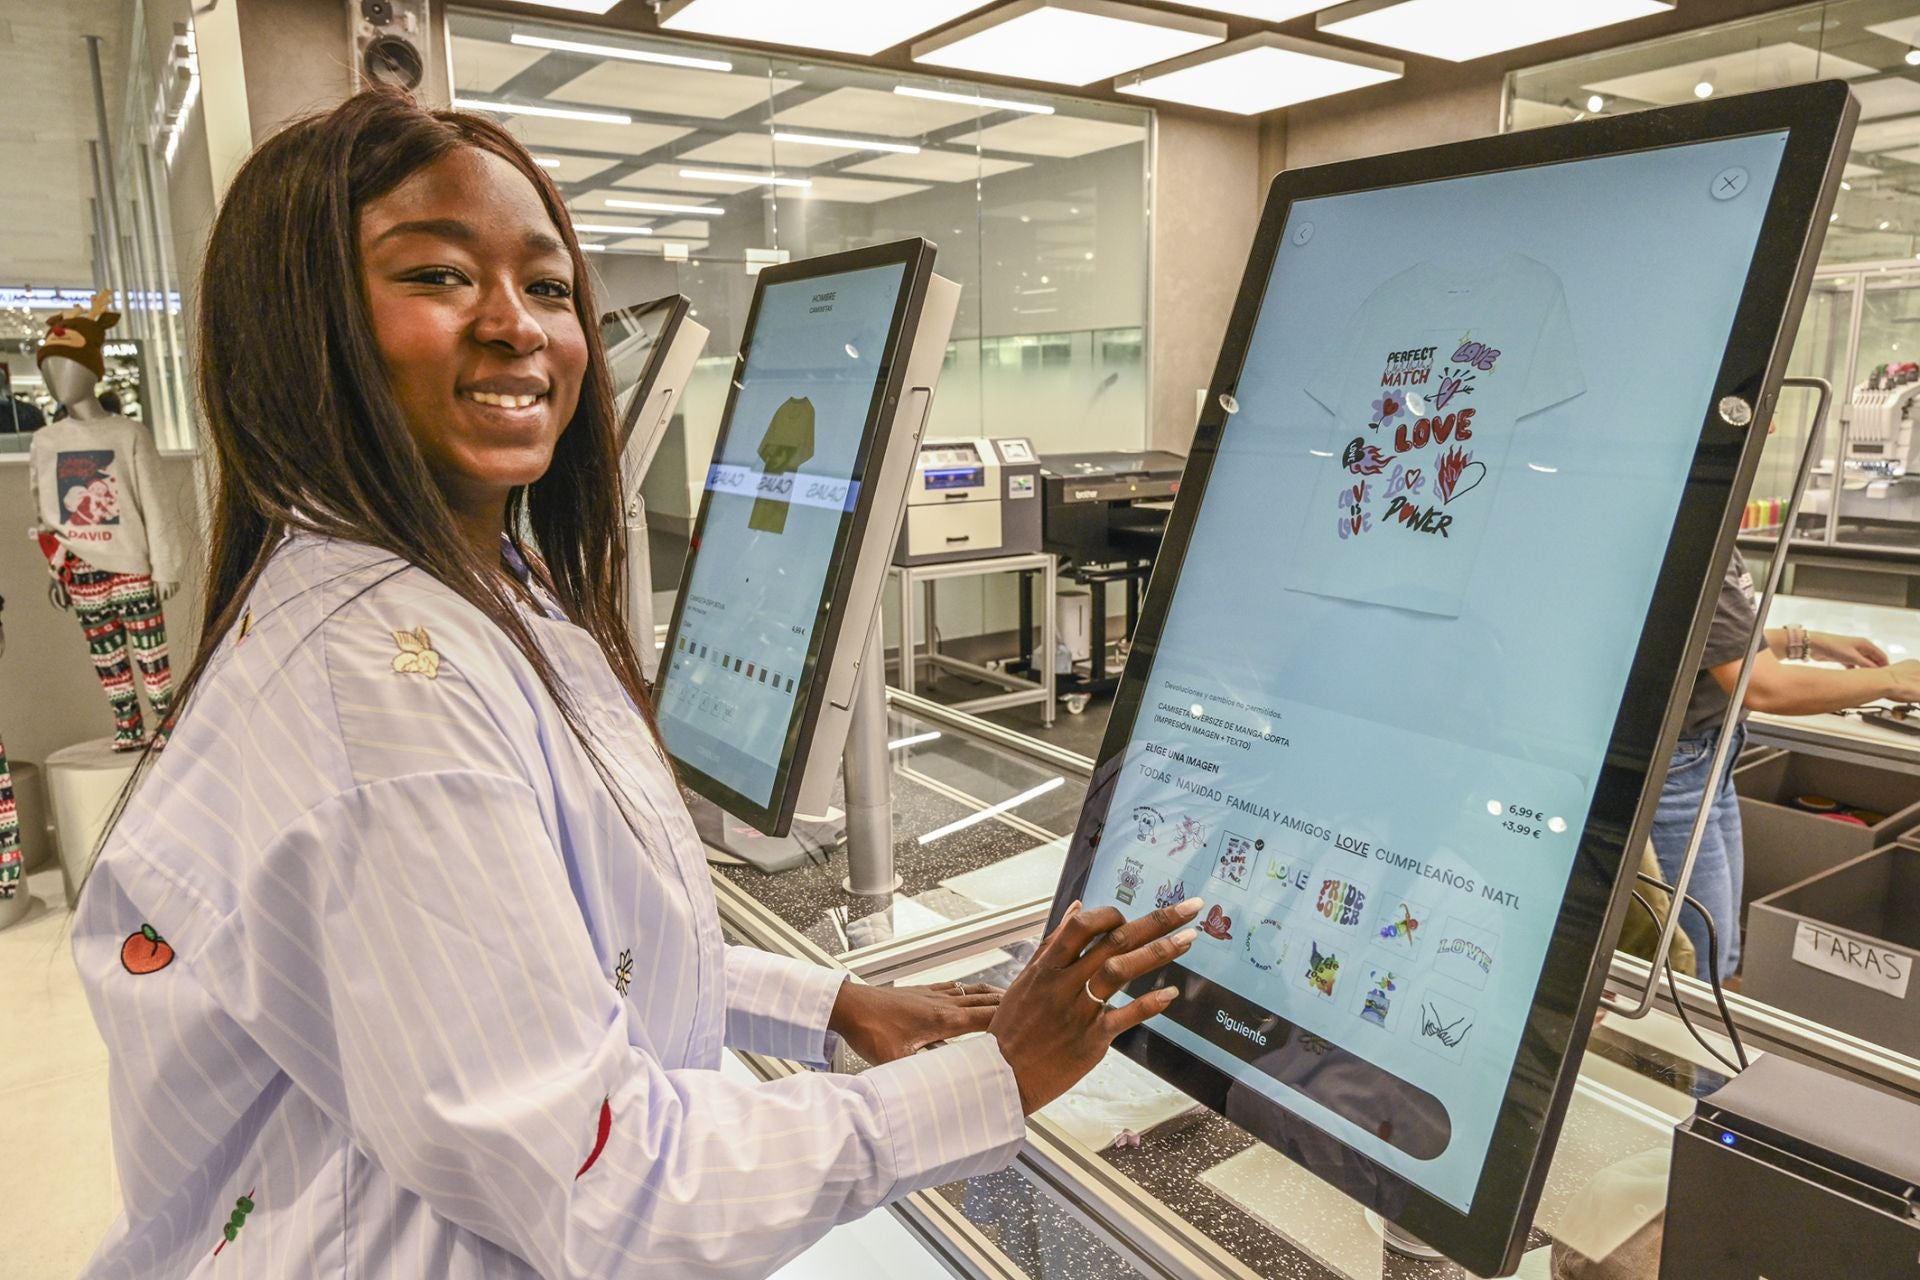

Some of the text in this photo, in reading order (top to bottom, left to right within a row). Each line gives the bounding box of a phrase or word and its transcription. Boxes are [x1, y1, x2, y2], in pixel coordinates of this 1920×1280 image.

[1387, 346, 1438, 363] PERFECT
[1451, 341, 1501, 371] LOVE
[1381, 368, 1431, 387] MATCH
[1394, 408, 1476, 453] LOVE
[1338, 480, 1373, 509] LOVE
[68, 531, 112, 541] DAVID
[1338, 514, 1373, 540] LOVE
[1164, 681, 1203, 698] Devoluciones
[1209, 694, 1235, 707] cambios
[1236, 701, 1244, 709] no
[1154, 714, 1192, 732] (IMPRESIÓN
[1192, 726, 1220, 740] IMAGEN
[1226, 735, 1252, 751] TEXTO)
[1158, 702, 1190, 718] CAMISETA
[1224, 721, 1235, 731] DE
[1235, 724, 1263, 739] MANGA
[1264, 733, 1290, 748] CORTA
[1145, 742, 1220, 774] ELIGE UNA IMAGEN
[1139, 764, 1172, 784] TODAS
[1176, 777, 1222, 802] NAVIDAD
[1226, 795, 1270, 820] FAMILIA
[1272, 810, 1282, 822] Y
[1281, 815, 1332, 841] AMIGOS
[1333, 833, 1371, 857] LOVE
[1375, 848, 1475, 893] CUMPLEAÑOS
[1509, 805, 1544, 822] 6,99 €
[1502, 820, 1542, 839] +3,99 €
[1316, 895, 1361, 926] LOVER
[1320, 880, 1366, 911] PRIDE
[1437, 938, 1493, 974] LOVE
[1804, 926, 1901, 980] TARAS
[1305, 969, 1328, 986] Love
[1215, 1009, 1267, 1046] Siguiente
